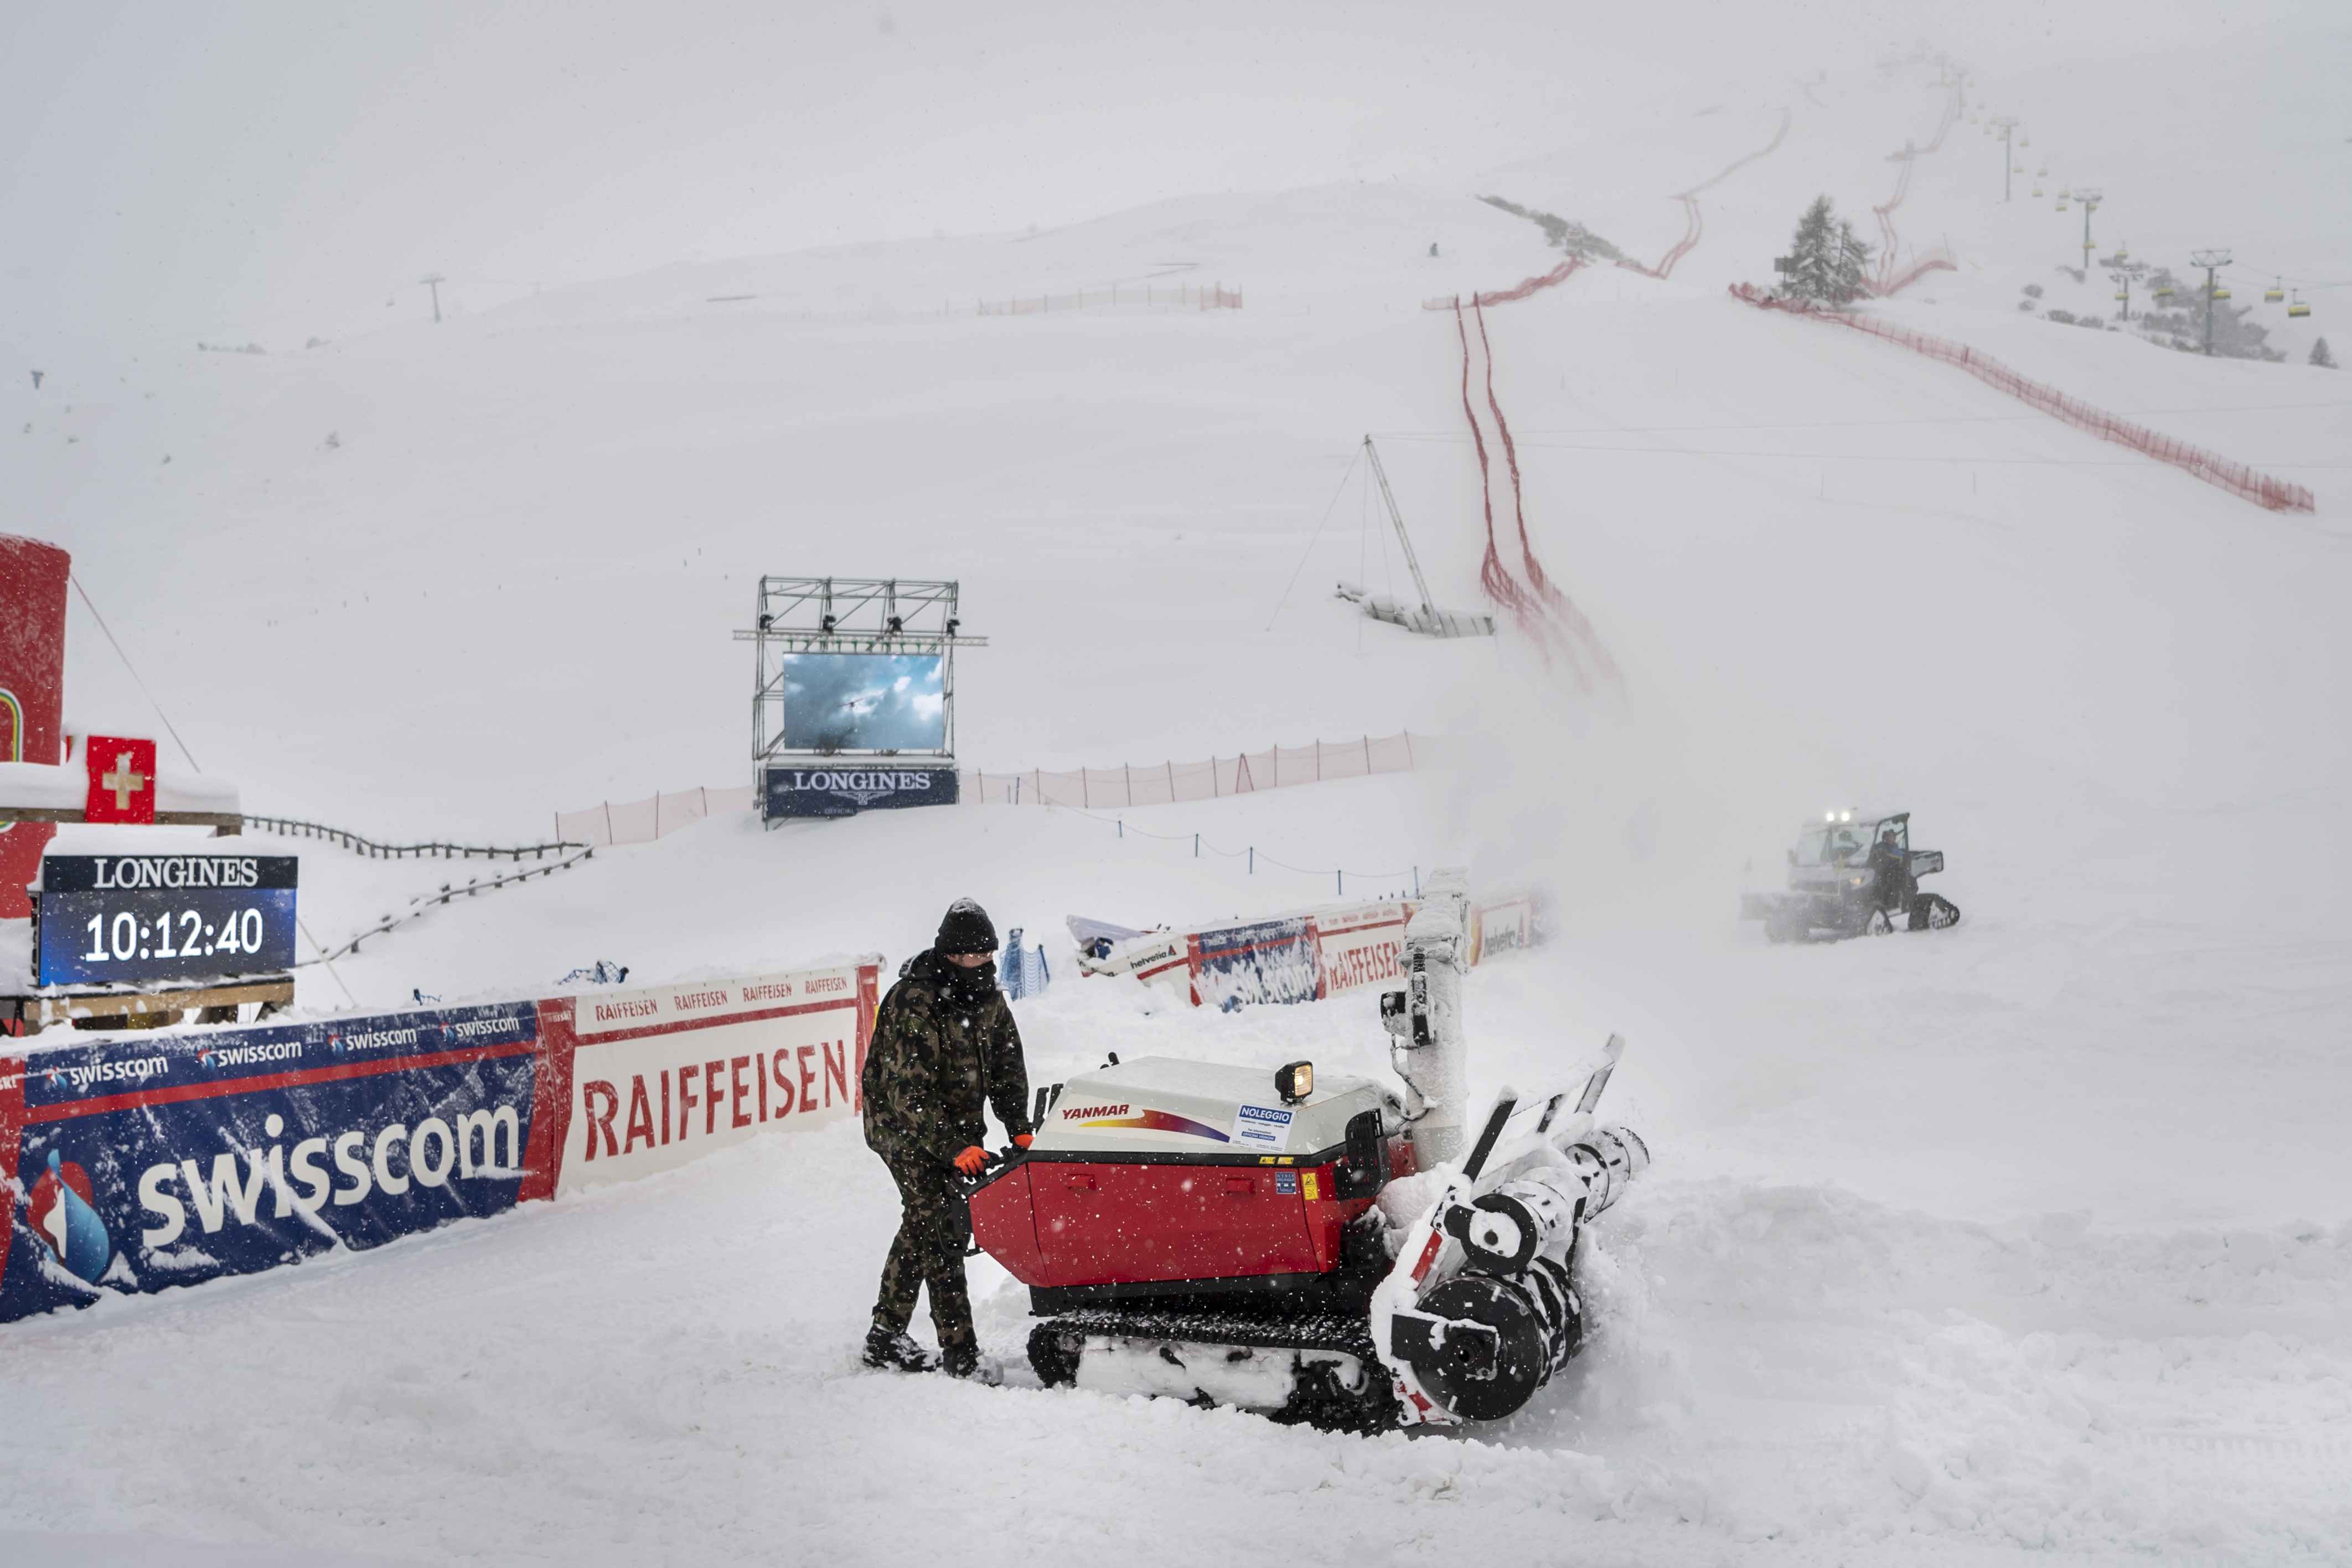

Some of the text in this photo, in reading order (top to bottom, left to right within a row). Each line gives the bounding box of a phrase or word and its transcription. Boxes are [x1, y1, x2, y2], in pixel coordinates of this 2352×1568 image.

[794, 772, 931, 790] LONGINES
[94, 858, 259, 888] LONGINES
[86, 908, 263, 962] 10:12:40
[596, 977, 847, 1022] RAIFFEISEN RAIFFEISEN RAIFFEISEN RAIFFEISEN
[70, 1015, 520, 1085] swisscom swisscom swisscom swisscom
[583, 1039, 849, 1163] RAIFFEISEN
[1062, 1104, 1130, 1121] YANMAR
[1242, 1107, 1290, 1122] NOLEGGIO
[138, 1105, 519, 1248] swisscom
